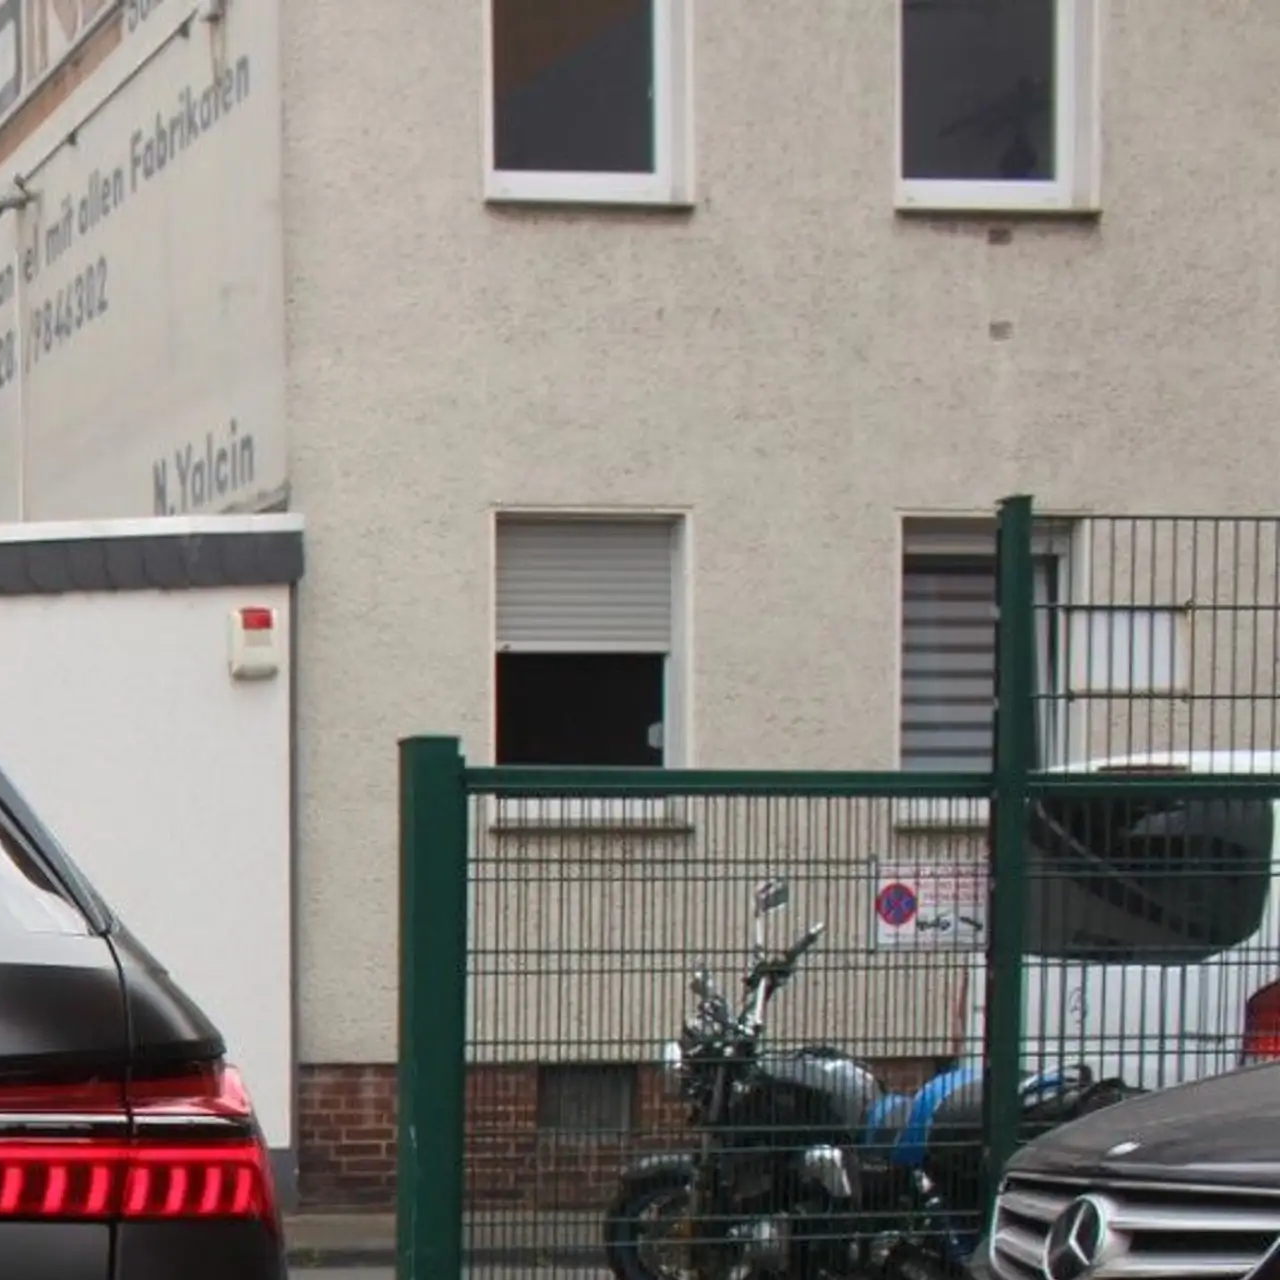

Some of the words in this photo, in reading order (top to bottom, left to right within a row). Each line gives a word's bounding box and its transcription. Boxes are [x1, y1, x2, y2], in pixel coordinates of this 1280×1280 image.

[46, 194, 73, 267] mit
[79, 167, 125, 236] allen
[130, 55, 249, 193] Fabrikaten
